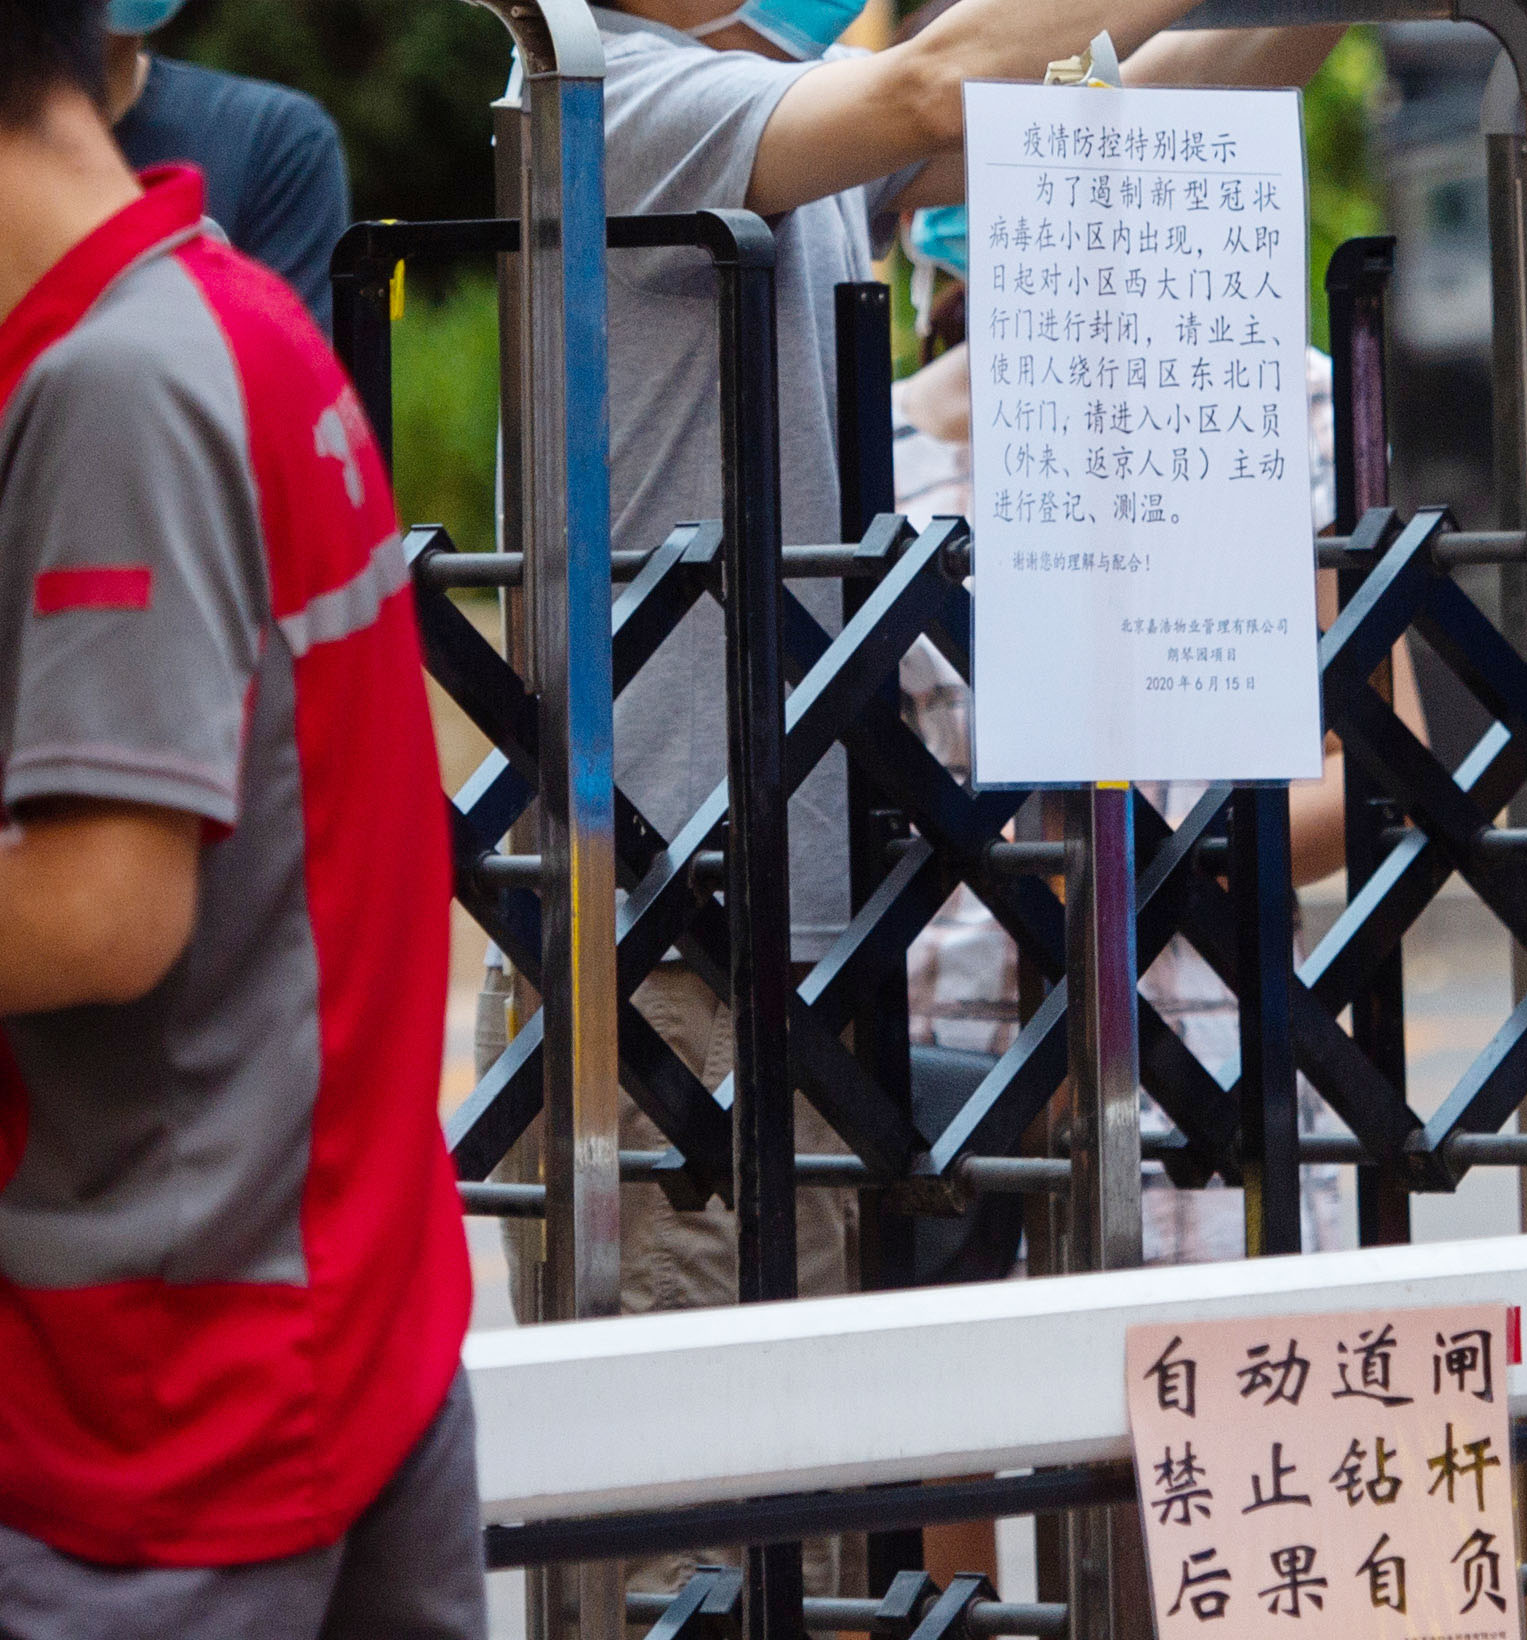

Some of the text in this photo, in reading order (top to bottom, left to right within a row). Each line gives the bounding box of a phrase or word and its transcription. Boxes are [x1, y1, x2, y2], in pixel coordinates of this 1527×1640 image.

[1024, 122, 1238, 163] 疫情防控特别提示
[1036, 172, 1281, 211] 为了遏制新型冠状
[989, 215, 1281, 259] 病毒在小区内出现，从即
[992, 263, 1282, 301] 日起对小区西大门及人
[989, 307, 1282, 346] 行门进行封闭，请业主、
[990, 354, 1281, 392] 使用人绕行园区东北门
[992, 489, 1180, 524] 进行登记、测温。
[1142, 1322, 1495, 1419] 自动道闸
[1150, 1421, 1502, 1527] 禁止钻杆
[1165, 1528, 1508, 1623] 后果自负
